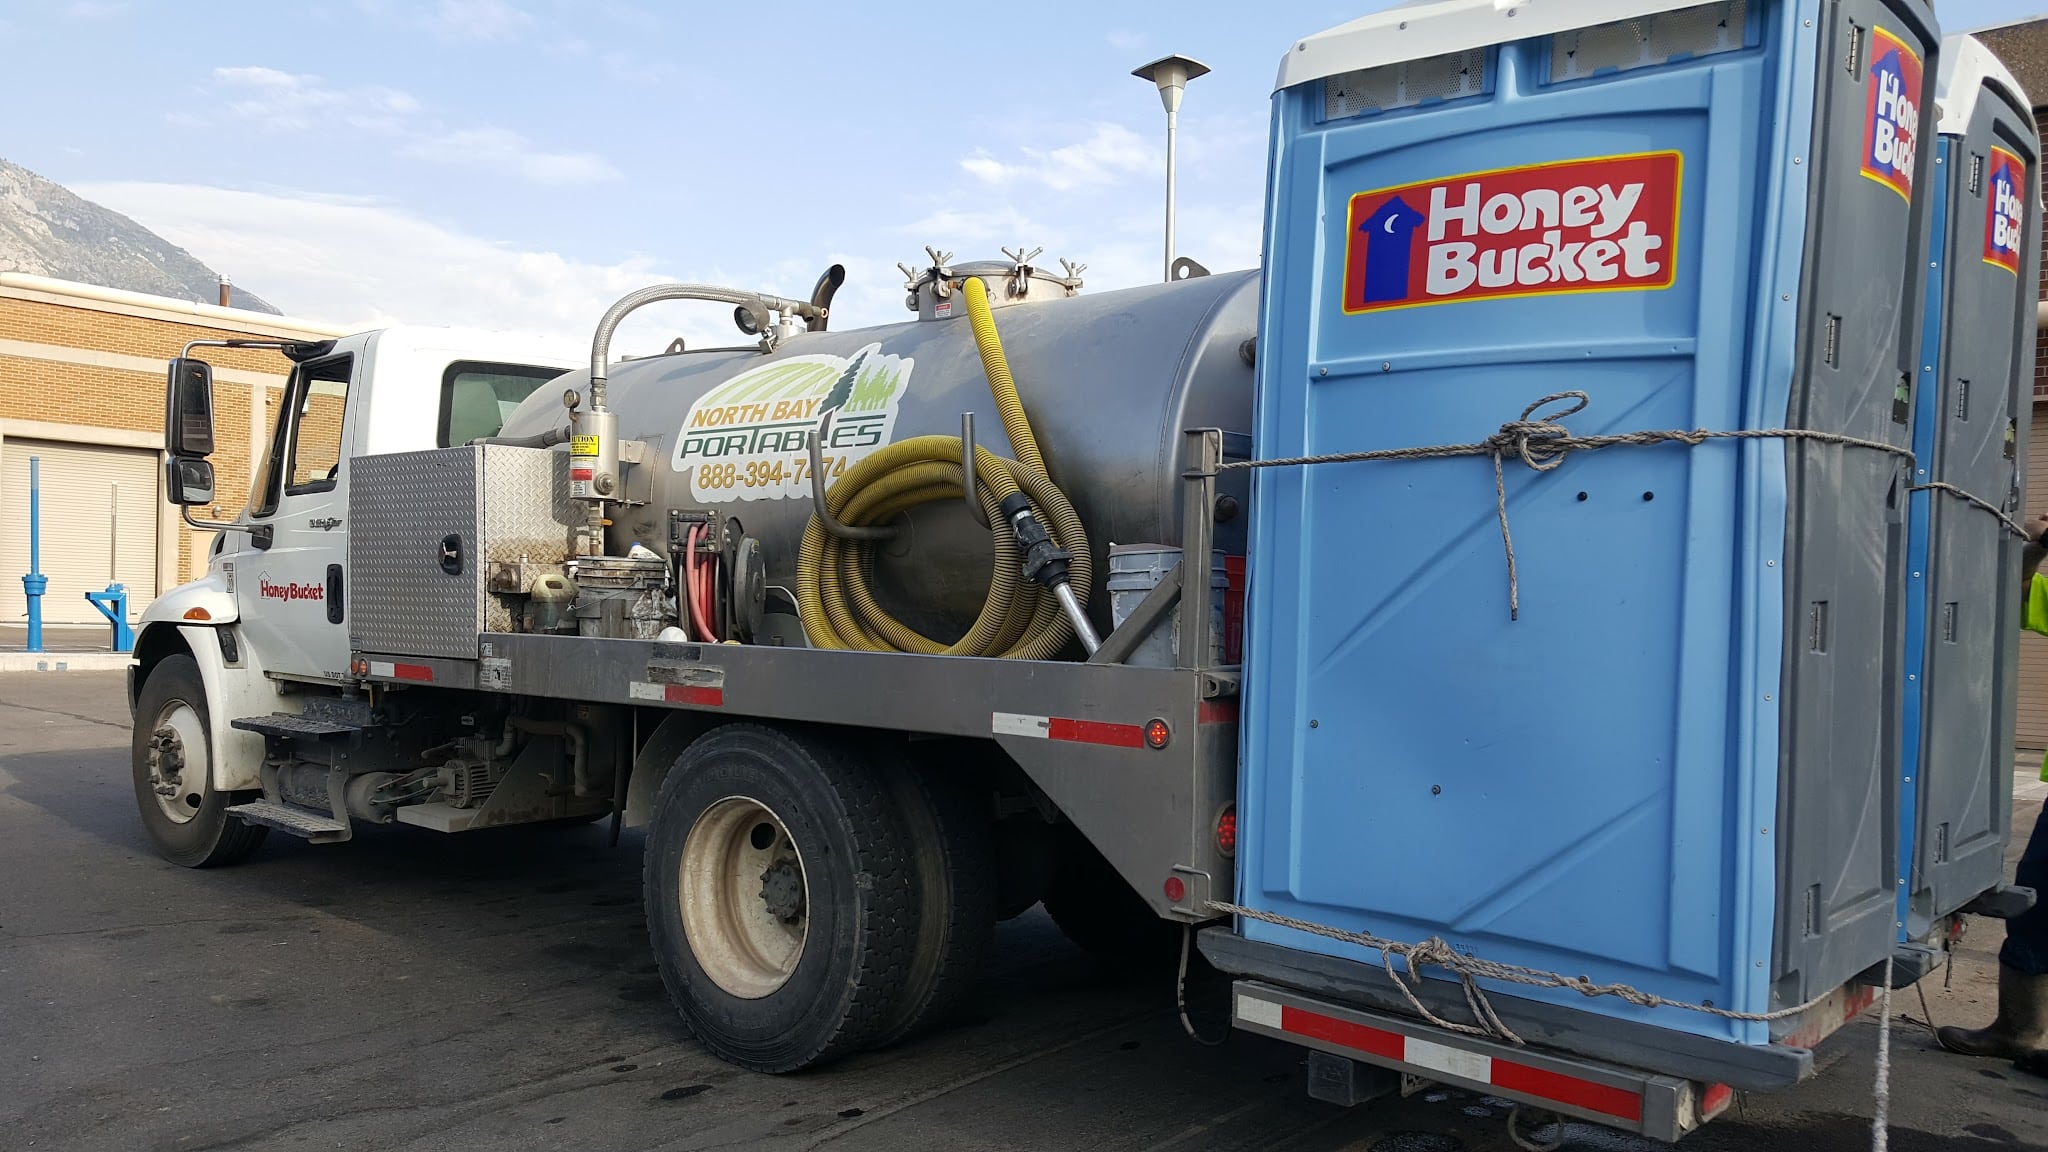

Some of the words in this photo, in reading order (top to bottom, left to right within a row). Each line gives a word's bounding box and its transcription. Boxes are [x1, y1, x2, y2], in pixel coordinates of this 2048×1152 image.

[1878, 69, 1919, 142] Hone
[1874, 118, 1917, 190] Buck
[1427, 183, 1644, 242] Honey
[1995, 179, 2023, 228] Hone
[1426, 221, 1662, 295] Bucket
[691, 403, 769, 428] NORTH
[771, 398, 822, 421] BAY
